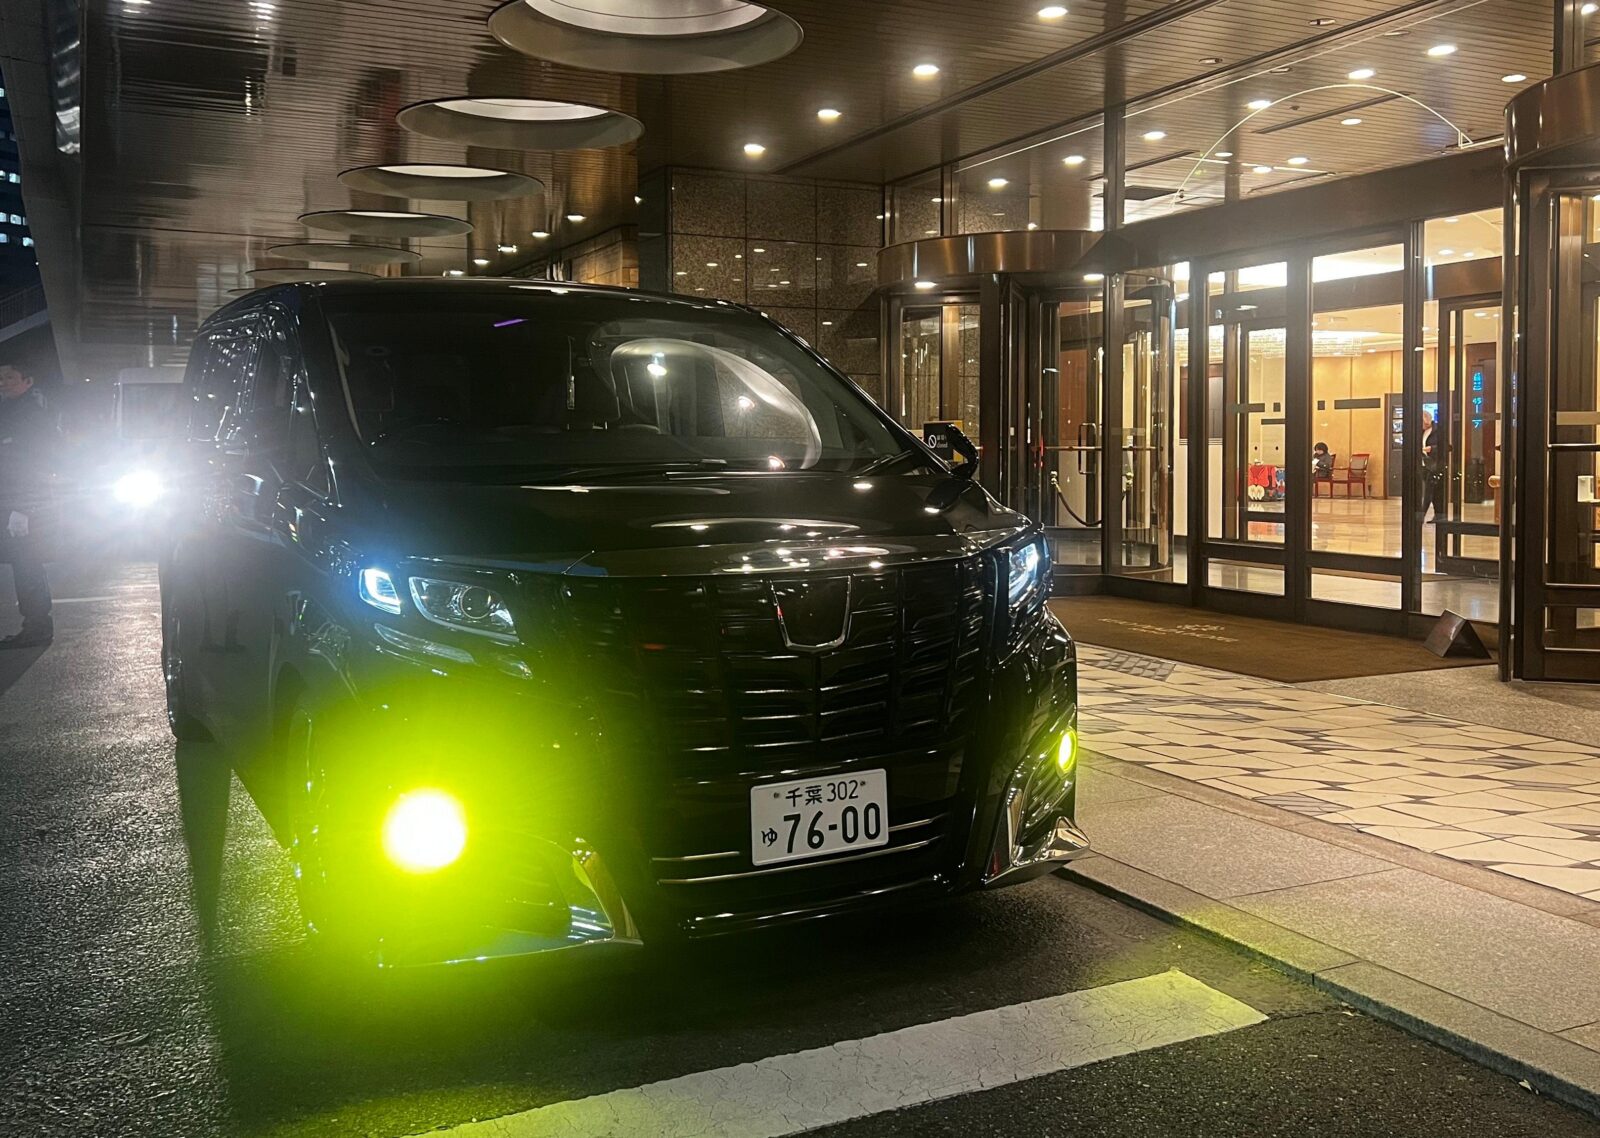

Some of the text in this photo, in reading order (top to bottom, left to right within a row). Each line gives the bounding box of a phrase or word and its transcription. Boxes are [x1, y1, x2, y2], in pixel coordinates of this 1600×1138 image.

[785, 779, 859, 808] 千葉 302
[761, 802, 881, 854] ゆ 76-00
